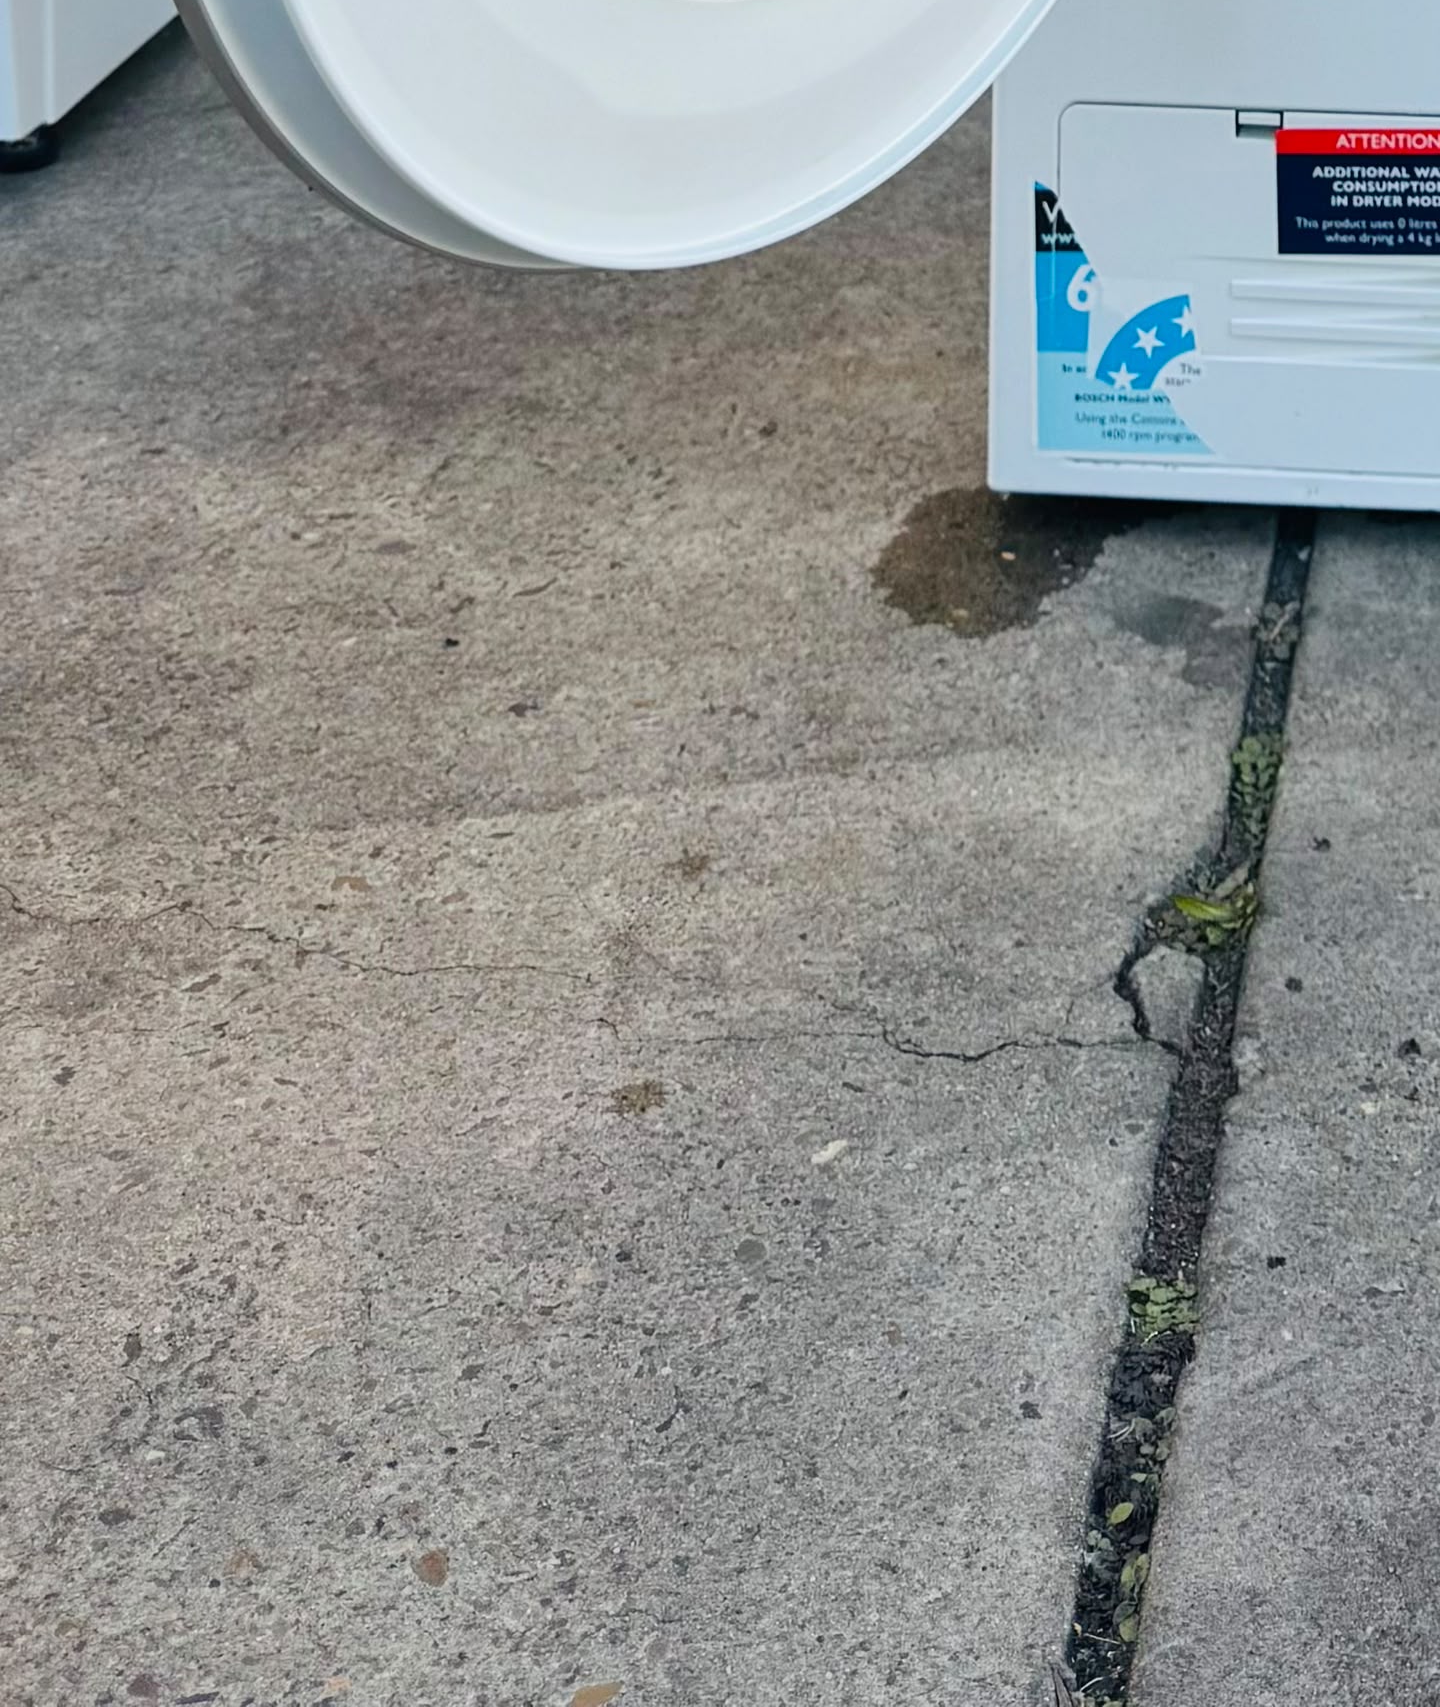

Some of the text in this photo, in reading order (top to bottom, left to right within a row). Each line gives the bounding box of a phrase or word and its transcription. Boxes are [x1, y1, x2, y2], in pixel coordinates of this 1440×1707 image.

[1312, 166, 1410, 178] ADDITIONAL
[1330, 195, 1348, 207] IN
[1352, 195, 1402, 207] DRYER
[1295, 215, 1319, 229] This
[1322, 218, 1366, 231] product
[1370, 220, 1394, 229] uses
[1325, 233, 1356, 243] when
[1359, 233, 1394, 246] drying
[1407, 233, 1415, 242] 4
